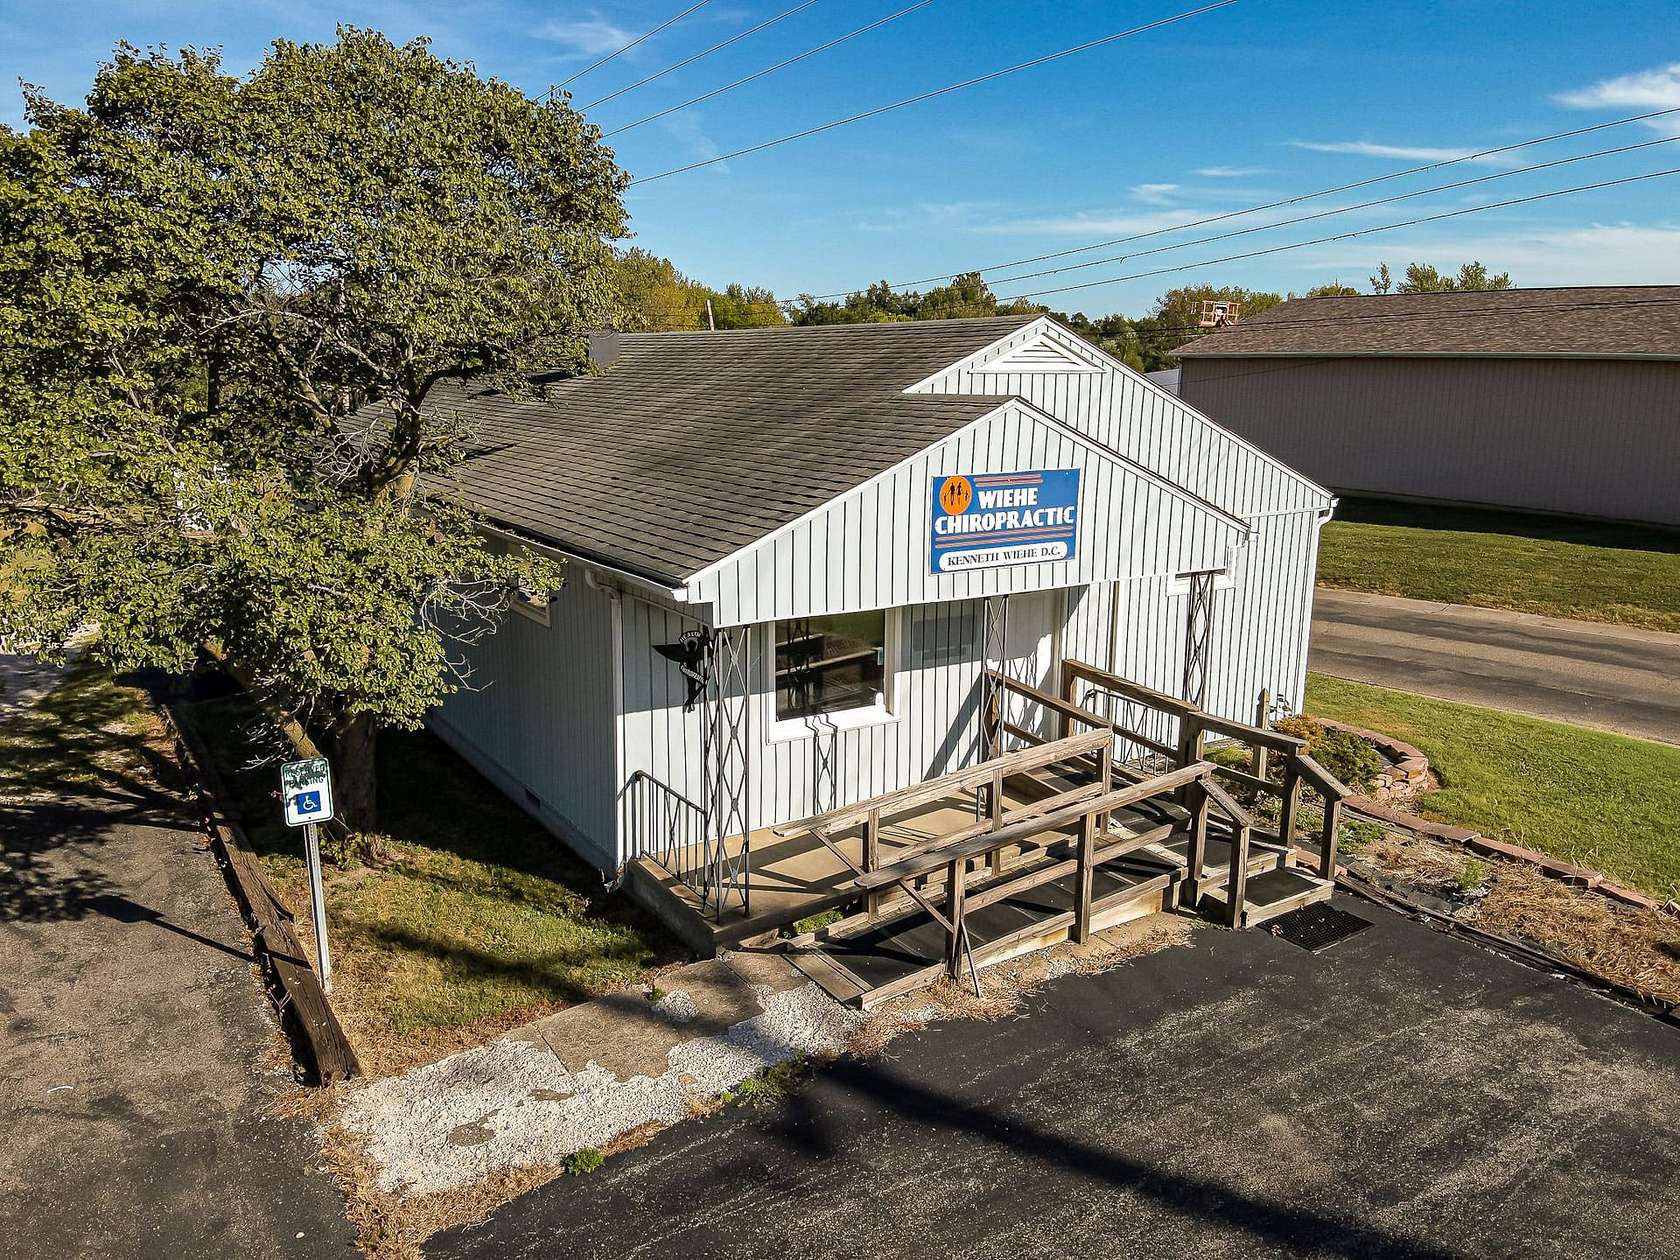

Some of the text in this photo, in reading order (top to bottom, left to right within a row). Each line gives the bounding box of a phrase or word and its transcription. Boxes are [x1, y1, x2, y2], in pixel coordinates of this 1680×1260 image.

[978, 488, 1038, 508] WIEHE
[935, 506, 1075, 534] CHIROPRACTIC
[948, 546, 1060, 566] KENNETH WIEHE D.C.
[289, 776, 324, 788] PARKING
